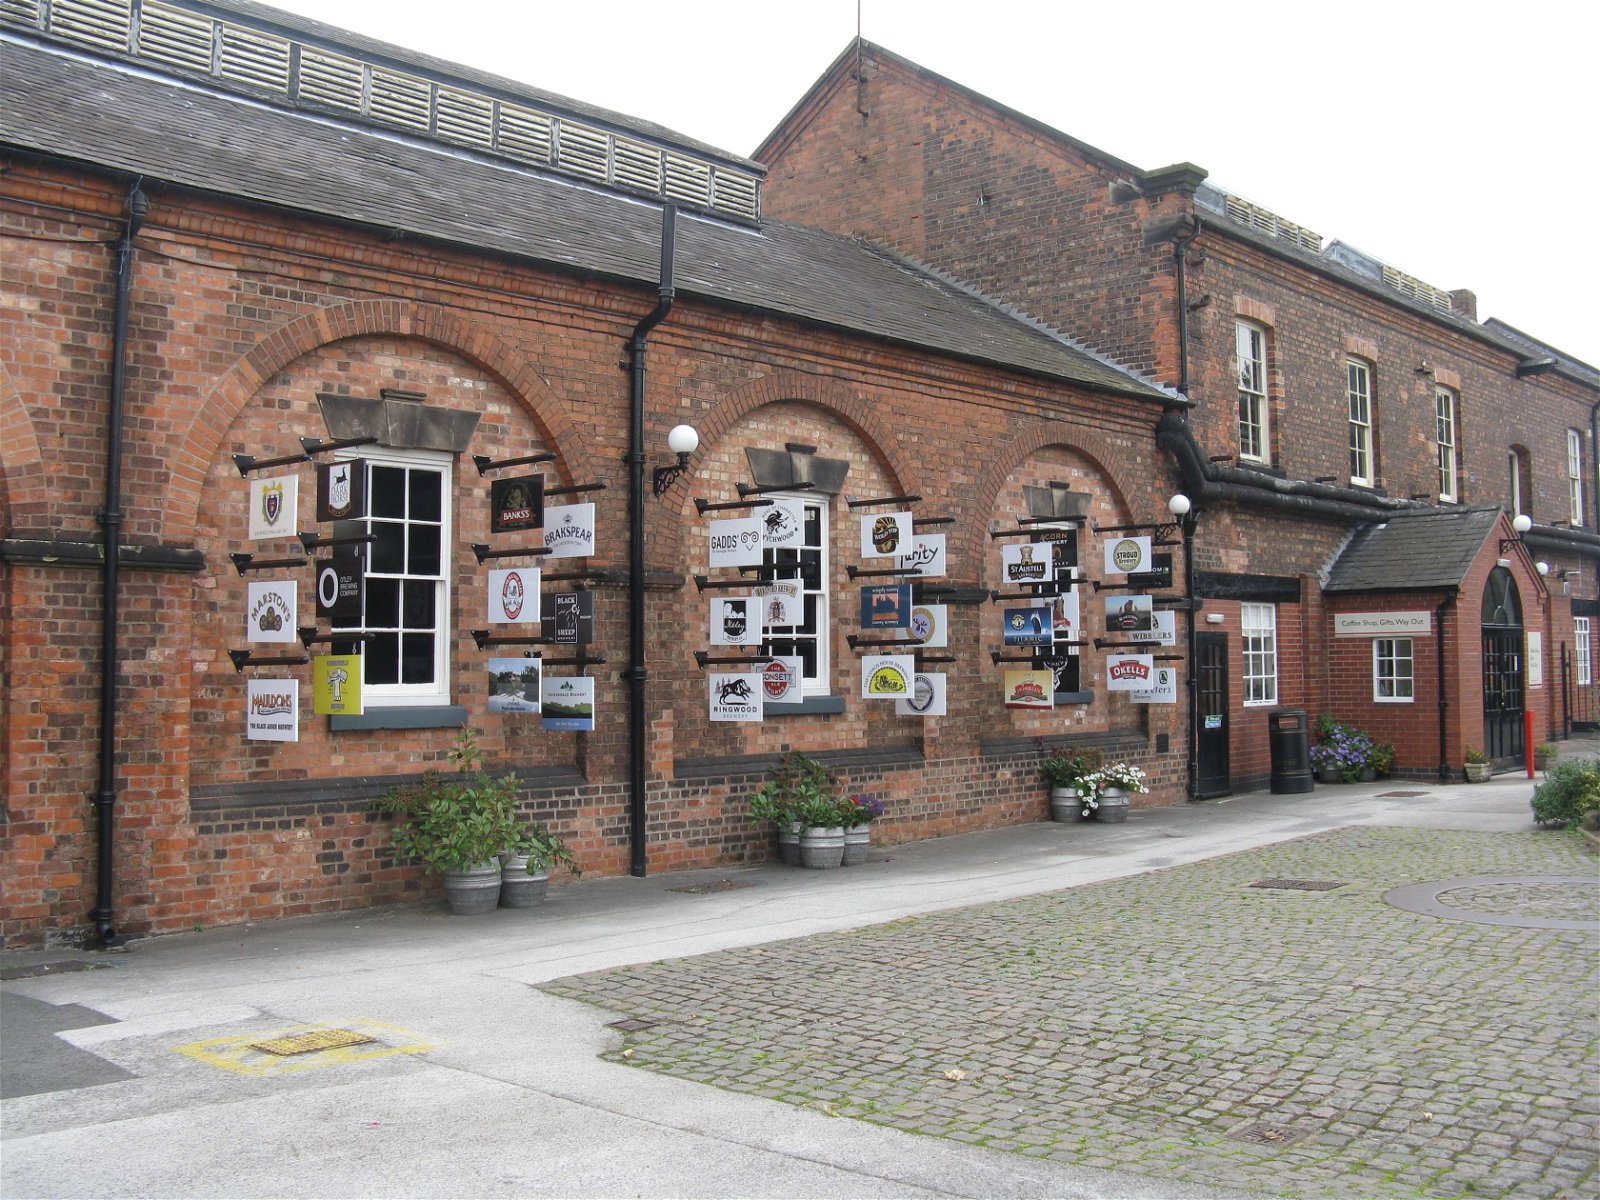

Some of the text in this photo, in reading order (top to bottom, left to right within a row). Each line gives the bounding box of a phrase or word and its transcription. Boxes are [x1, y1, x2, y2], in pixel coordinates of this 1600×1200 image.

[544, 526, 592, 546] BRAKSPEAR
[711, 536, 739, 549] GADDS'
[1116, 551, 1138, 559] STROUD
[1019, 565, 1043, 573] AUSTELL
[557, 597, 576, 605] BLACK
[251, 592, 291, 622] MARSTON'S
[1396, 618, 1410, 626] Way
[1013, 634, 1043, 642] TITANIC
[1132, 632, 1172, 640] WIBBLERS
[1113, 666, 1146, 676] OKELLS
